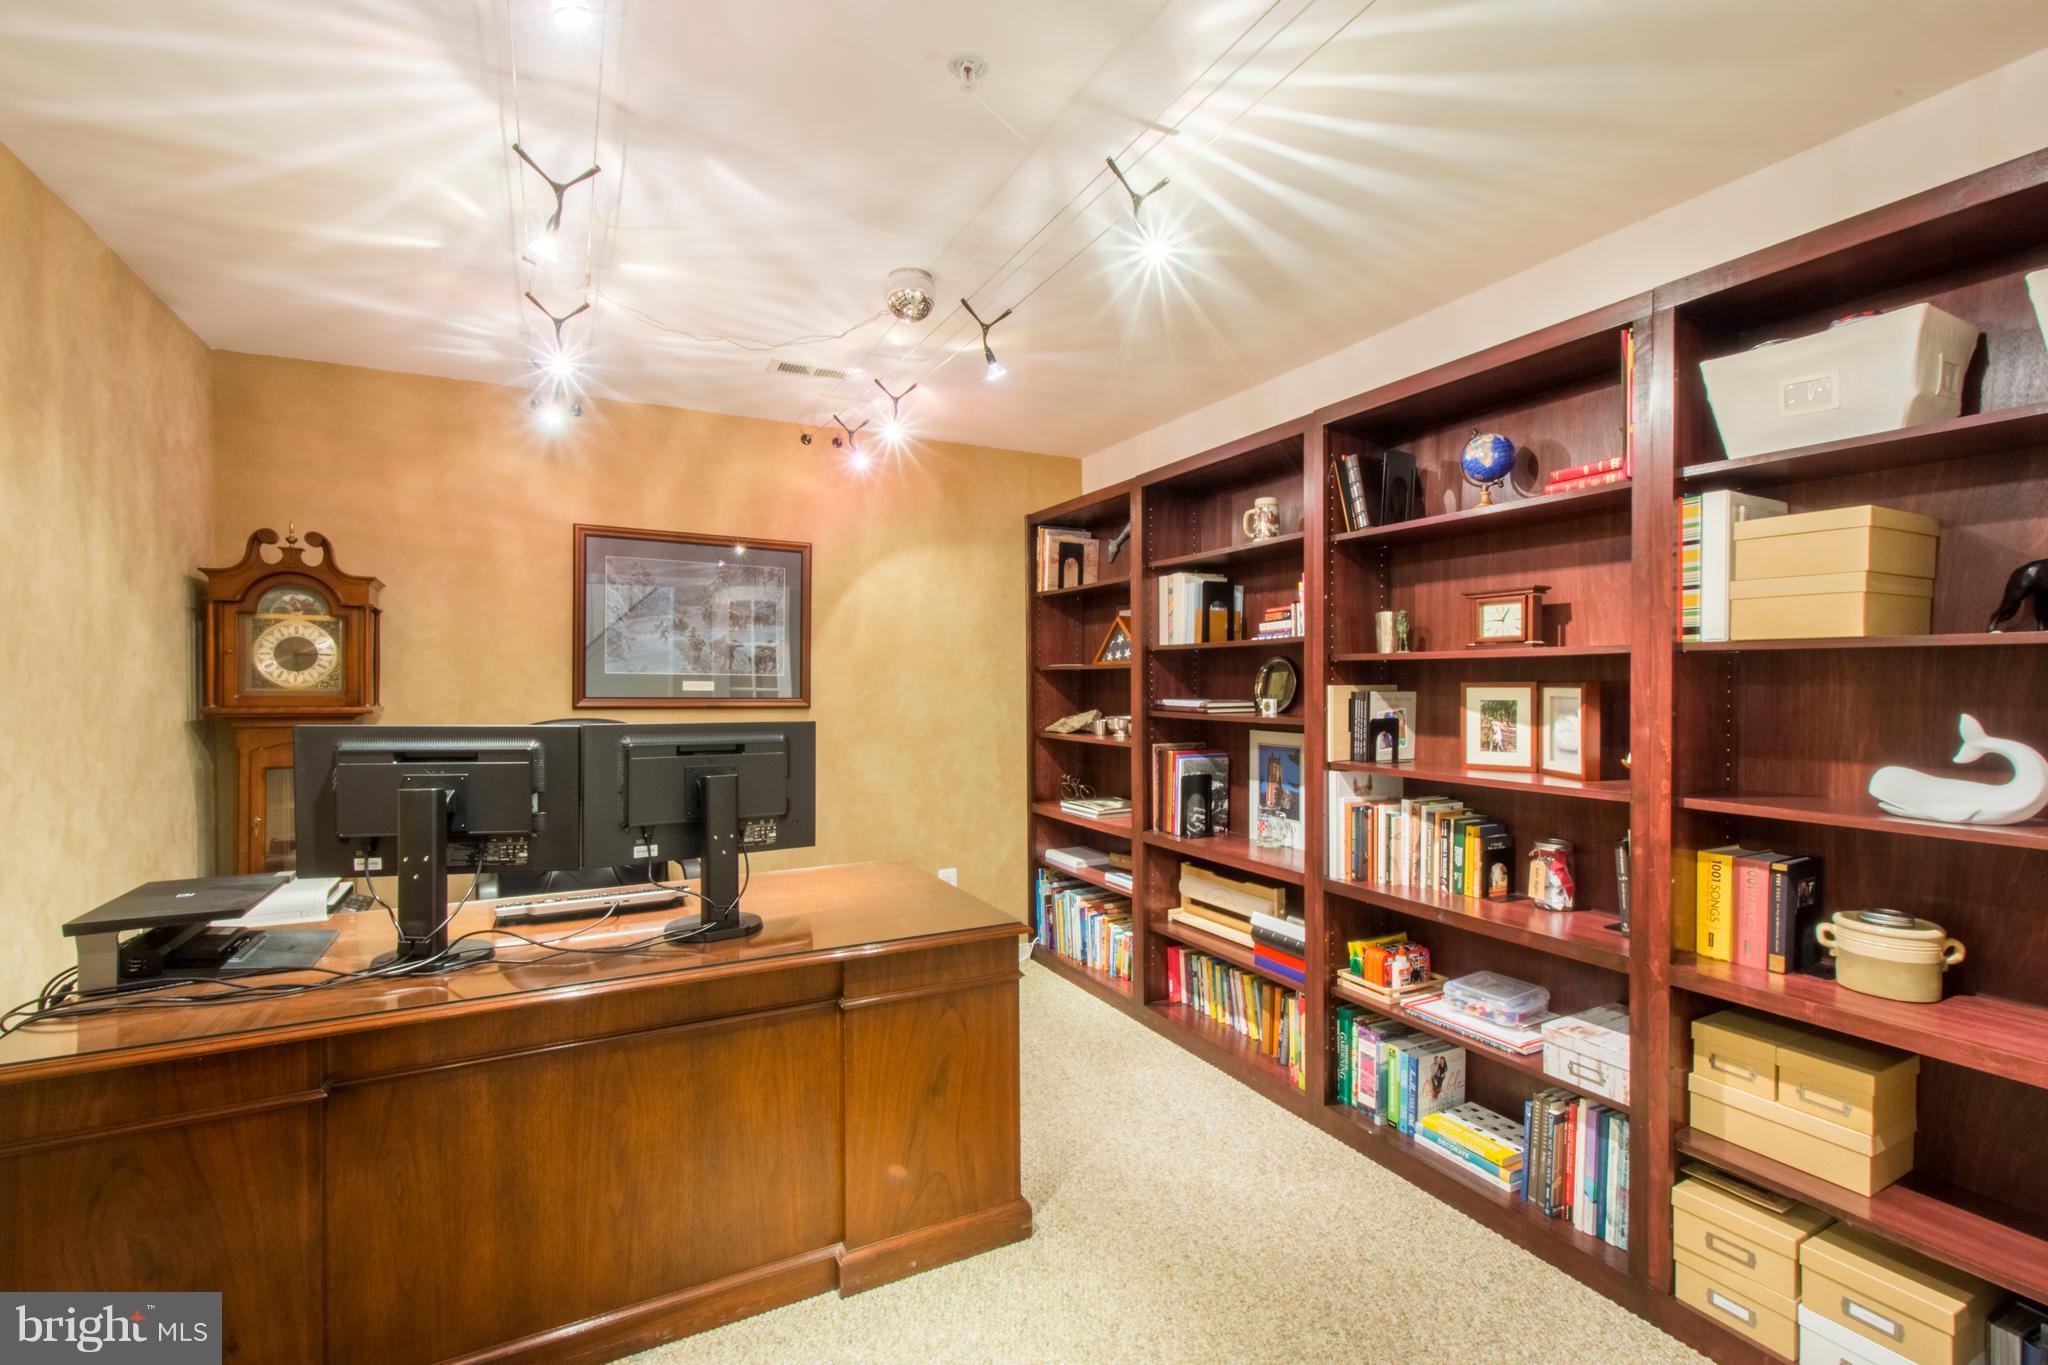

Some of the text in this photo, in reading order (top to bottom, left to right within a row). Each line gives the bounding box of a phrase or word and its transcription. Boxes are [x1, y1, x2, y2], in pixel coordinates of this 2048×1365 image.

[1711, 860, 1722, 883] 1001
[1709, 883, 1721, 923] SONGS
[1337, 1031, 1347, 1080] GARDENING
